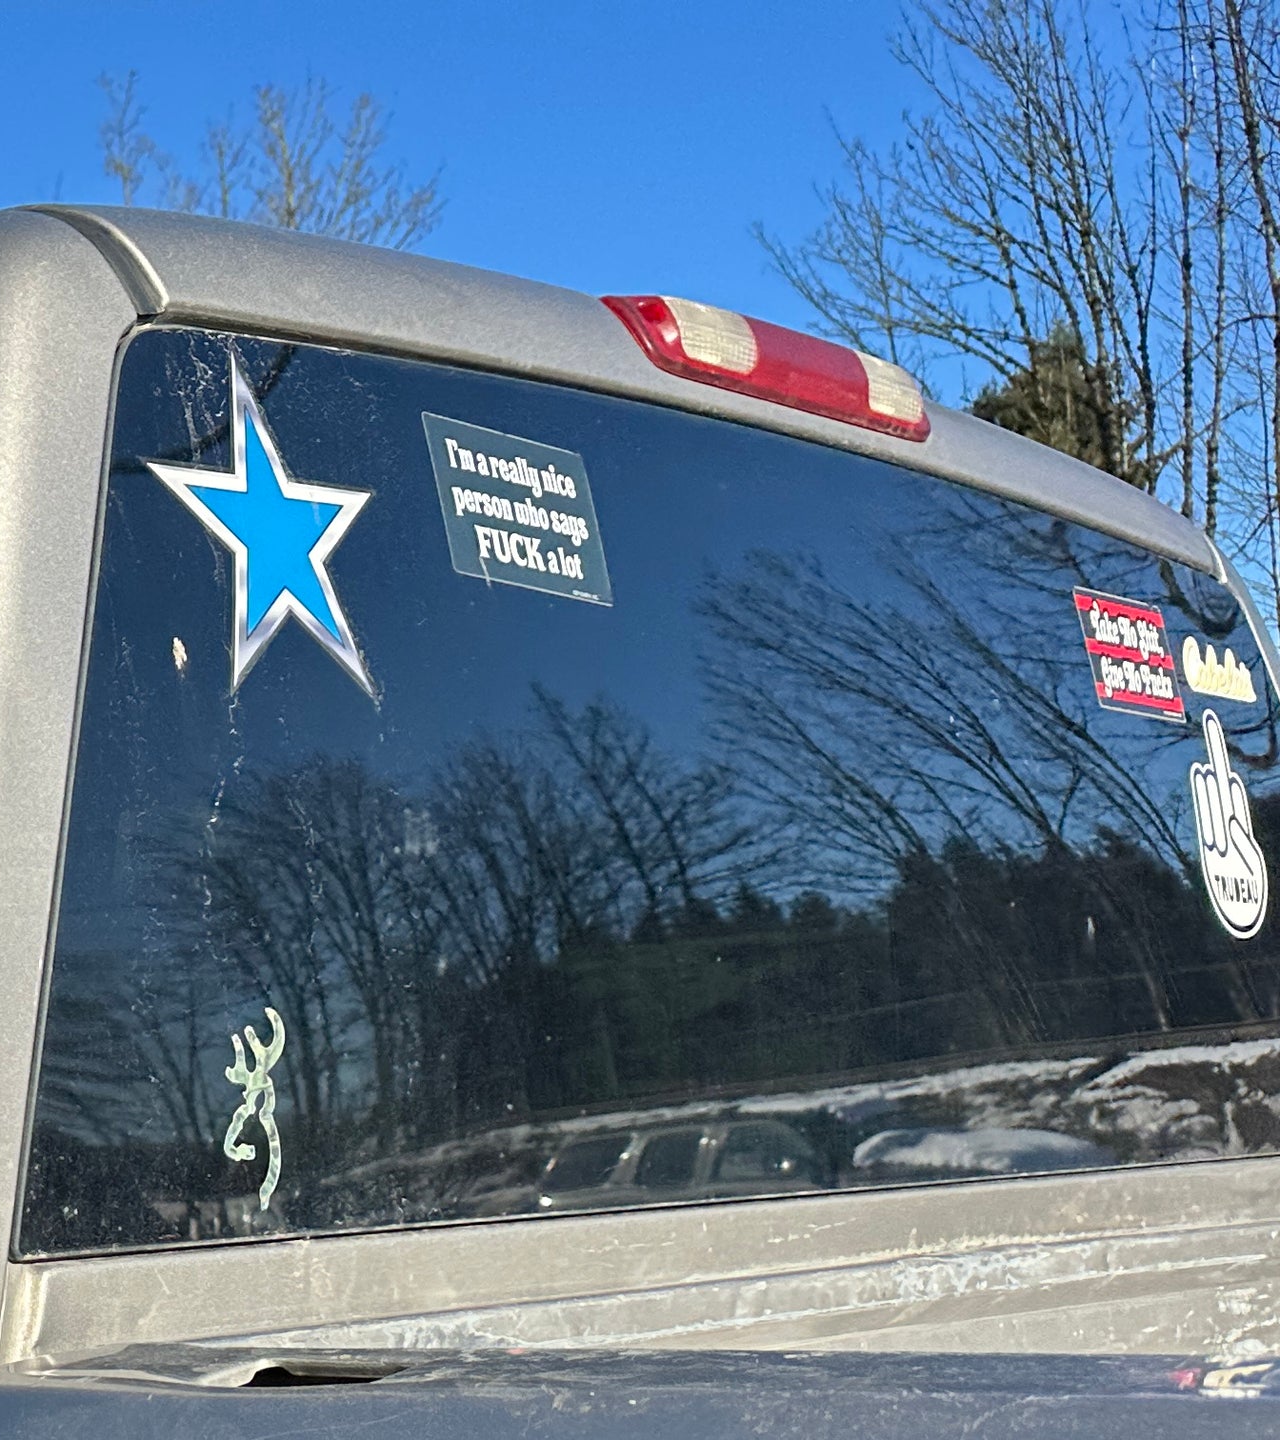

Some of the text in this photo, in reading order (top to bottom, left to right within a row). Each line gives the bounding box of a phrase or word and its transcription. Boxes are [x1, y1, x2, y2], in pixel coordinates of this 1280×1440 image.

[444, 438, 576, 498] I'm a really nice
[451, 486, 589, 546] person who says
[474, 524, 584, 580] FUCK a lot
[1090, 601, 1120, 644] Take
[1117, 616, 1138, 648] No
[1101, 656, 1125, 697] Give
[1123, 661, 1142, 692] No
[1214, 875, 1258, 904] TRUDEAU
